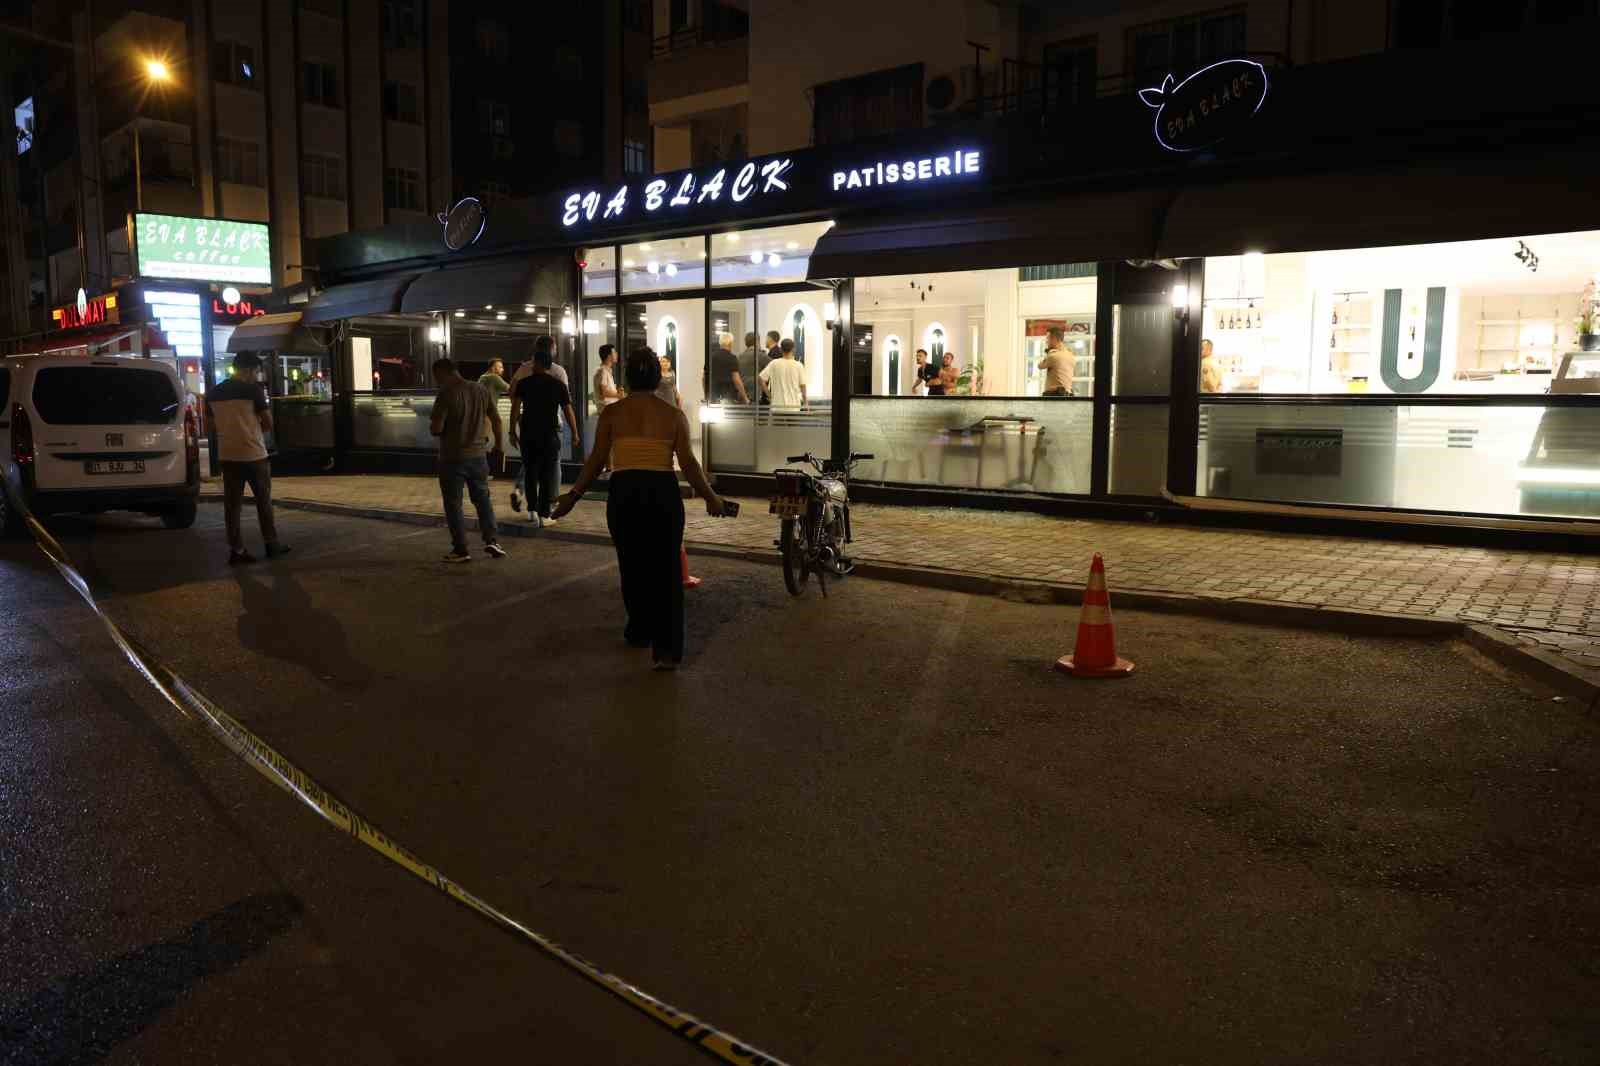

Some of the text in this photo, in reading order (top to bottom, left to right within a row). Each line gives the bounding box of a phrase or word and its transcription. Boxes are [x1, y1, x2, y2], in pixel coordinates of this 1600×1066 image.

[833, 149, 981, 191] PATİSSERİE
[562, 158, 791, 226] EVA BLACK
[145, 220, 265, 252] EVA BLACK
